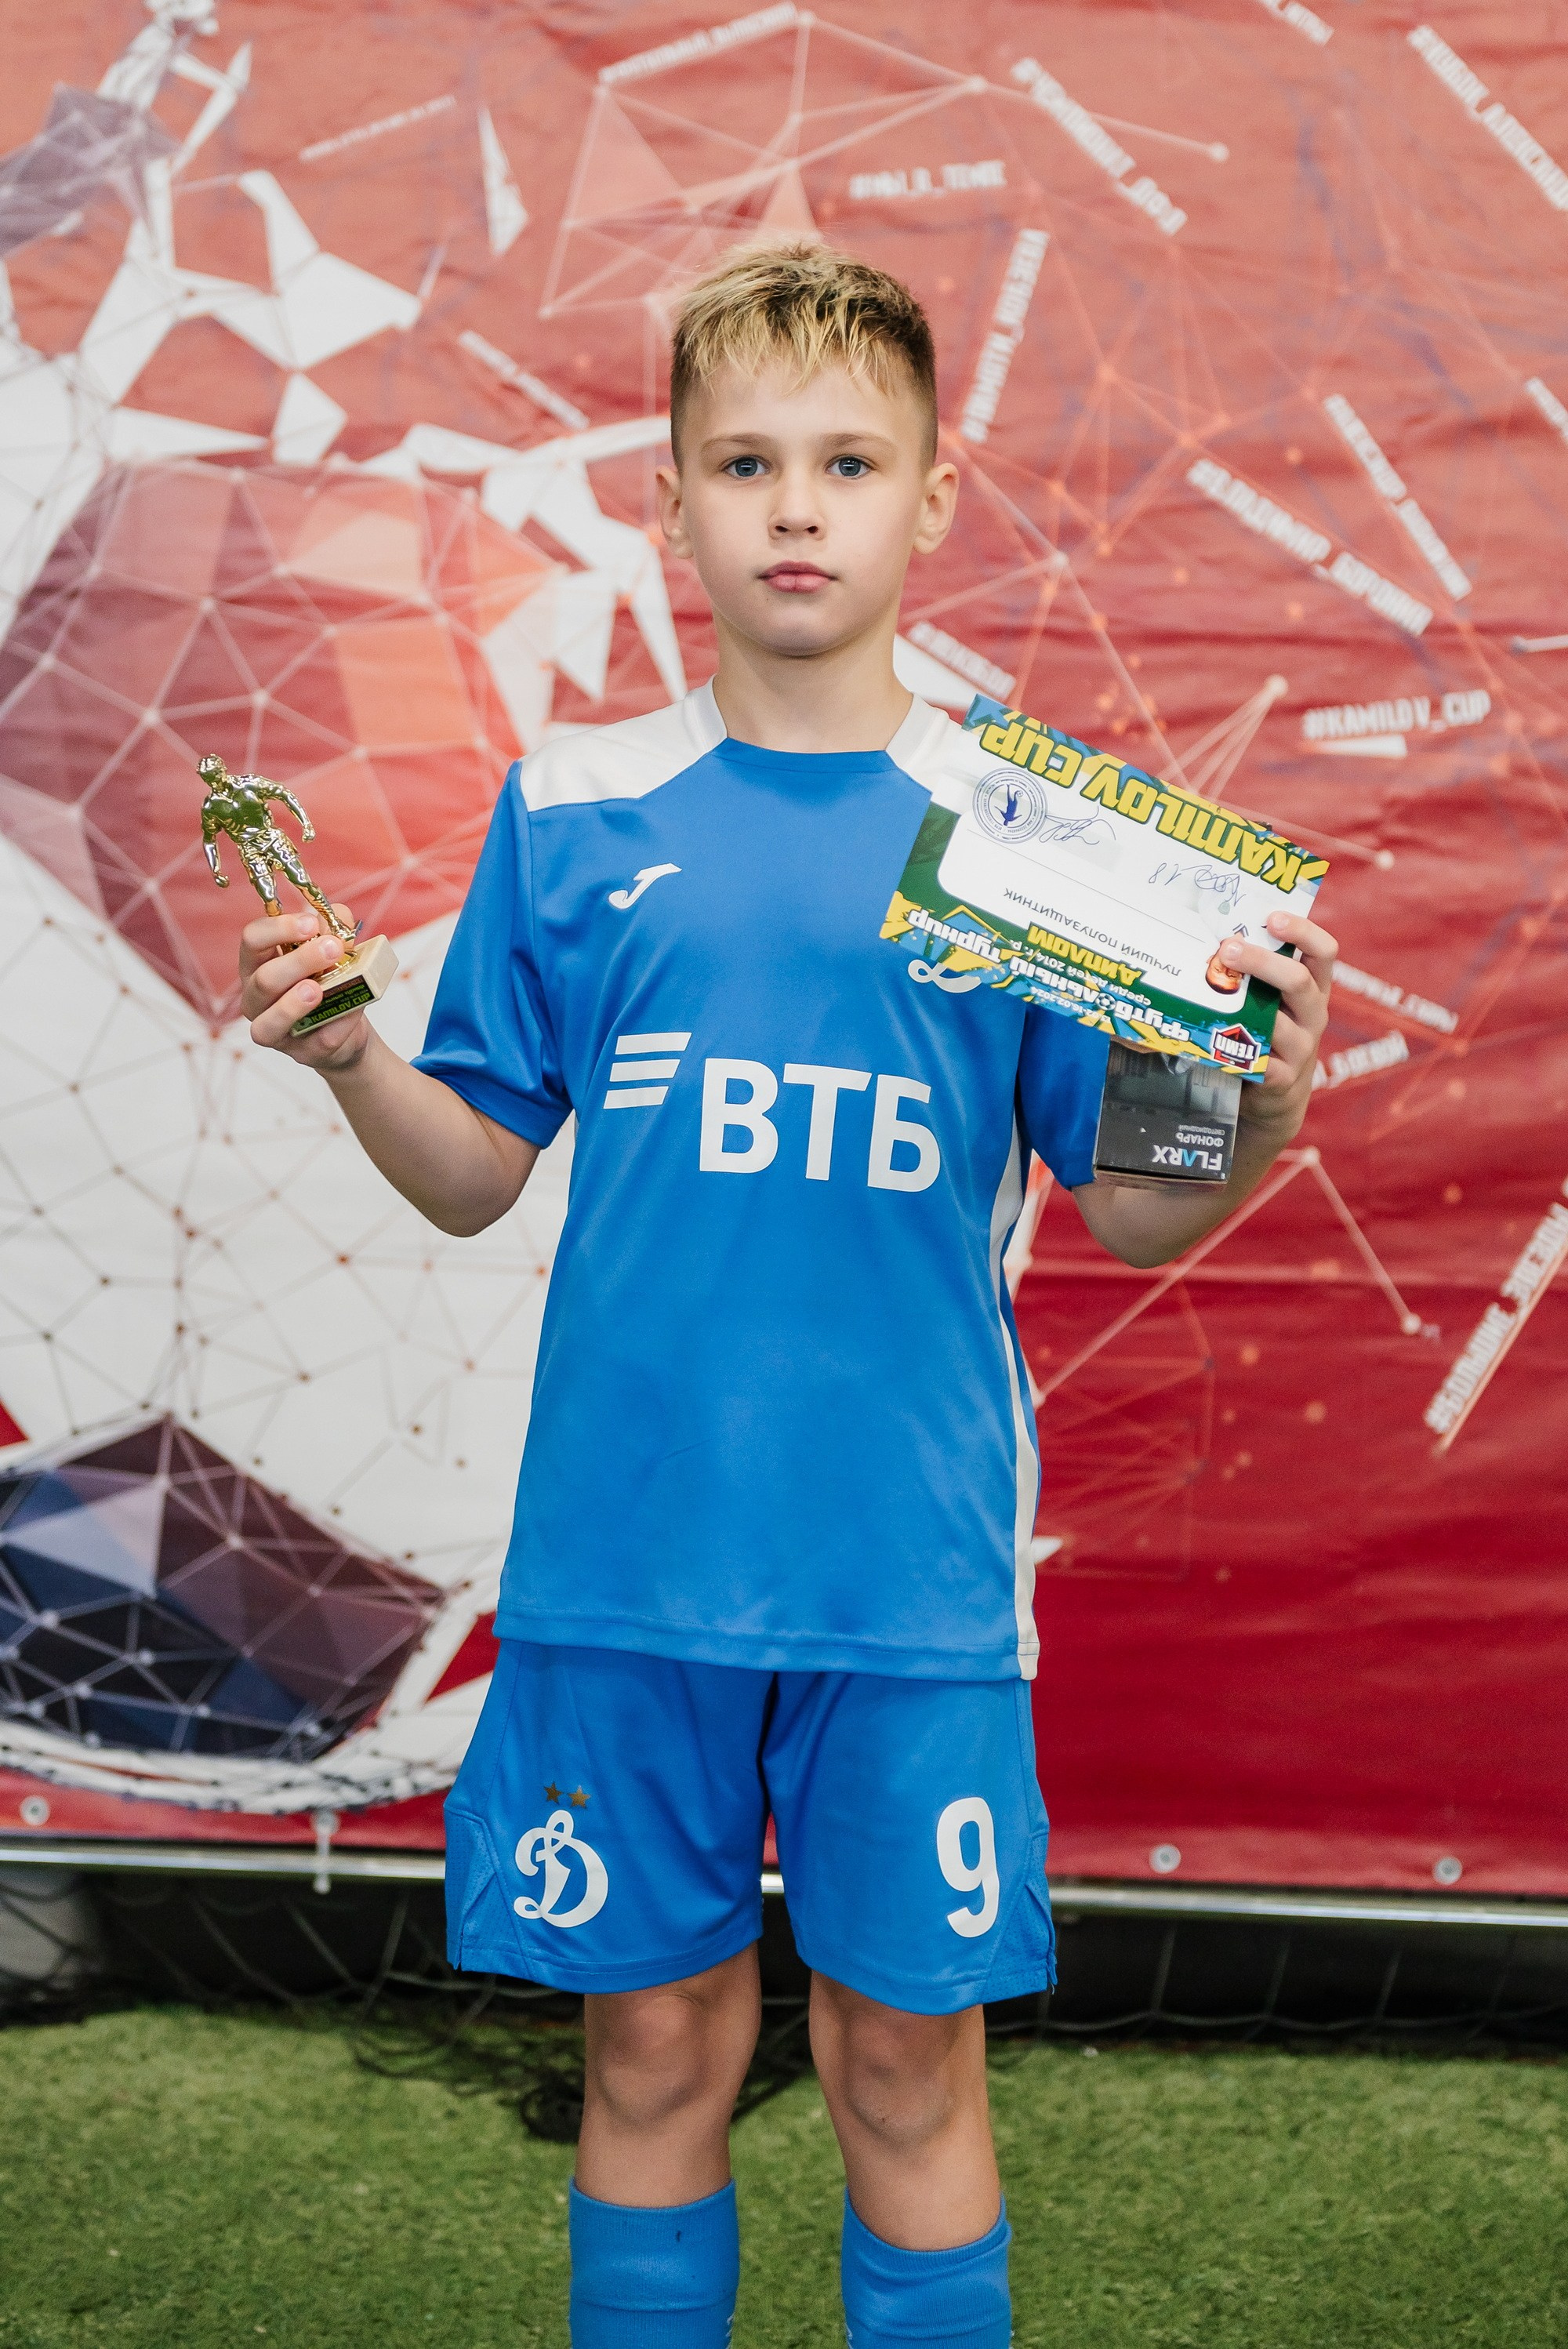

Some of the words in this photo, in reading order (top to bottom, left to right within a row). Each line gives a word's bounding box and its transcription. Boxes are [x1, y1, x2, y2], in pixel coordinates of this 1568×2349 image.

[1303, 690, 1490, 739] #KAMILOV_CUP
[981, 722, 1083, 787] CUP
[1085, 765, 1301, 892] KAMILOV
[1004, 888, 1118, 947] ПОЛУЗАЩИТНИК
[908, 909, 1002, 964] турнир
[1027, 925, 1142, 986] ДИПЛОМ
[1035, 954, 1065, 971] 2014
[1121, 943, 1181, 976] ЛУЧШИЙ
[1066, 967, 1109, 988] детей
[1110, 983, 1151, 1005] среди
[311, 1001, 351, 1022] KAMILOV
[353, 992, 371, 1005] CUP
[1214, 1033, 1254, 1060] ТЕМП
[699, 1058, 941, 1193] ВТБ
[1176, 1131, 1224, 1147] ФОНАРЬ
[1178, 1124, 1225, 1136] светодиодный
[1152, 1145, 1223, 1171] FLARX
[937, 1796, 1000, 1938] 9
